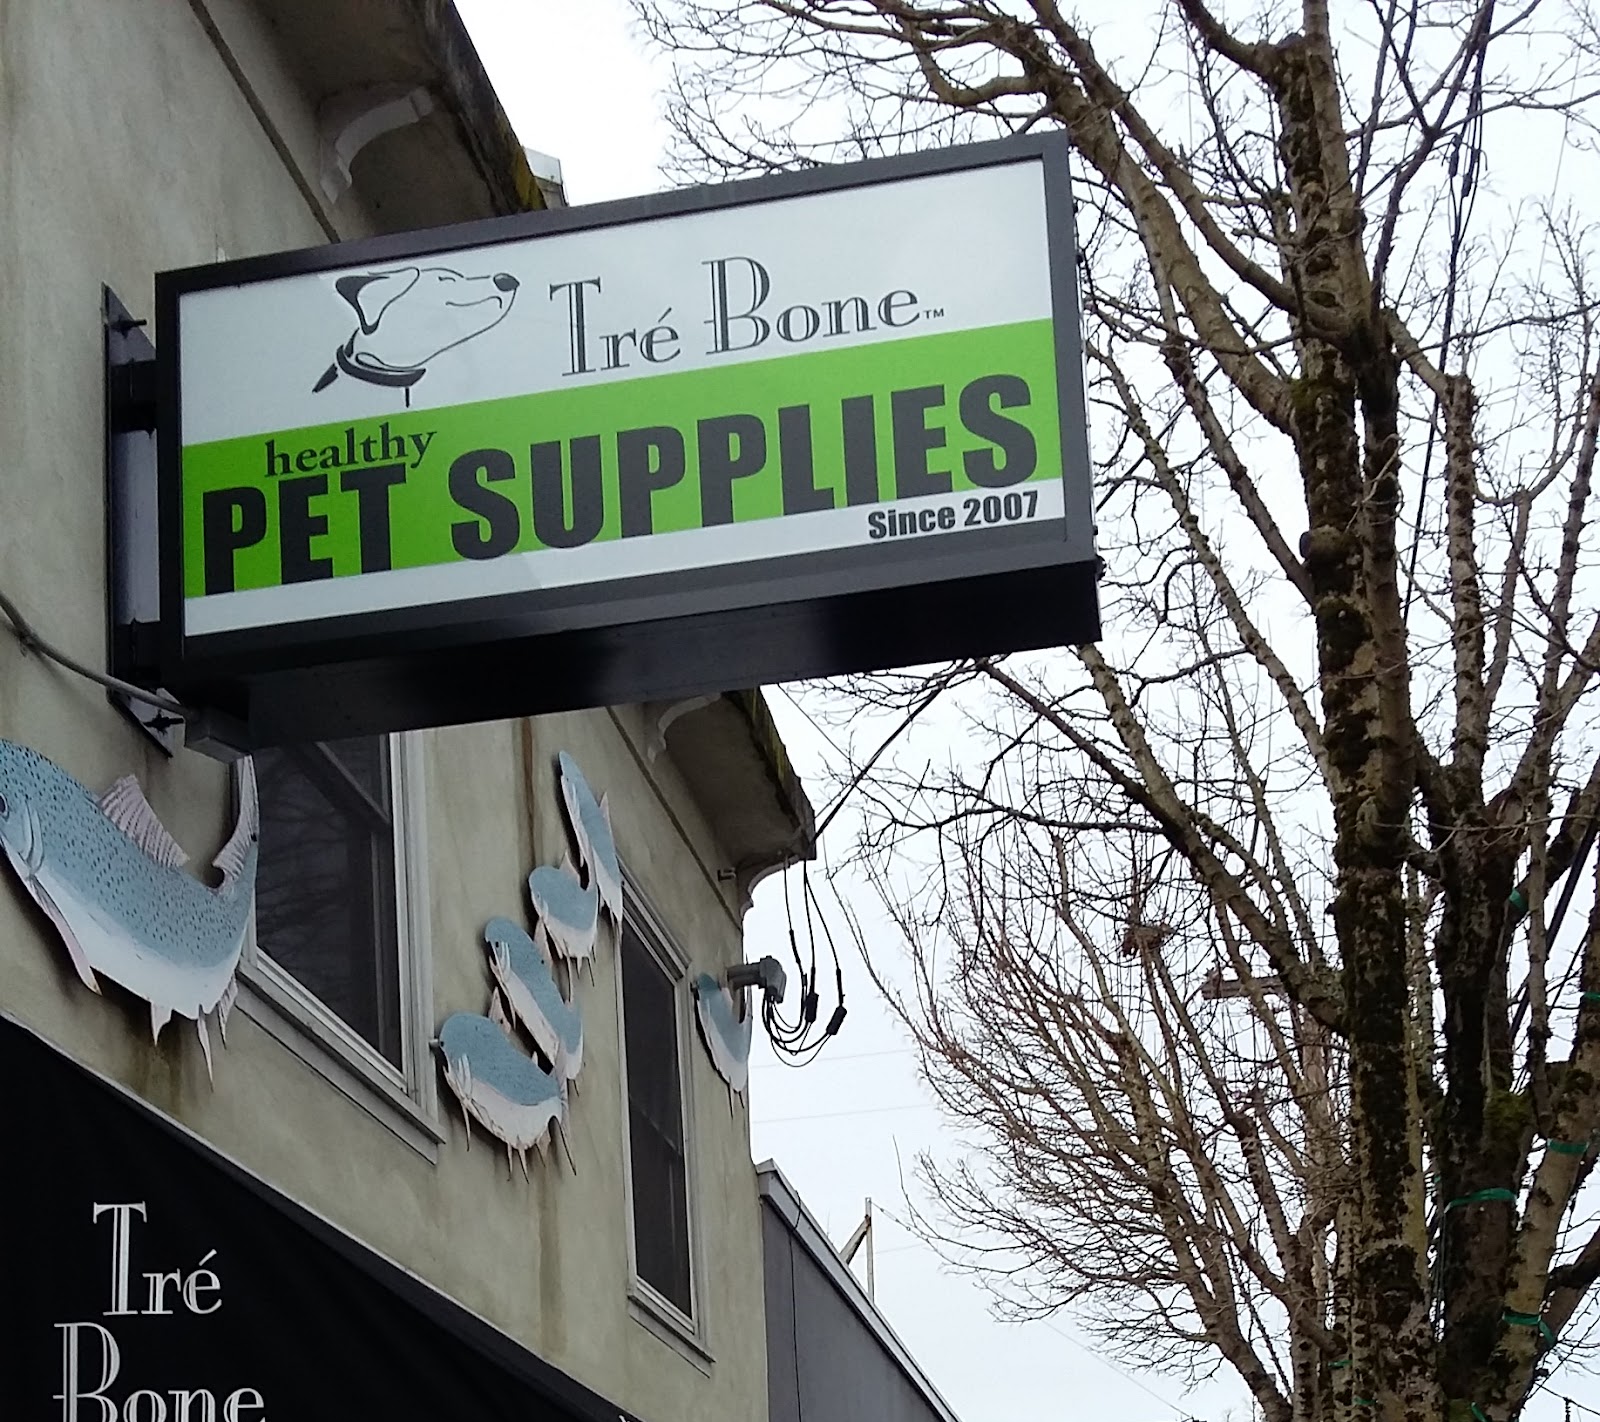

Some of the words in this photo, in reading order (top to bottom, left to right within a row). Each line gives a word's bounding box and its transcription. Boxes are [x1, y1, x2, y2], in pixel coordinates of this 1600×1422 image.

[549, 275, 681, 377] Tré
[202, 462, 407, 597] PET
[447, 373, 1038, 562] SUPPLIES
[263, 421, 437, 478] healthy
[867, 501, 958, 541] Since
[962, 489, 1038, 529] 2007
[92, 1200, 223, 1316] Tré
